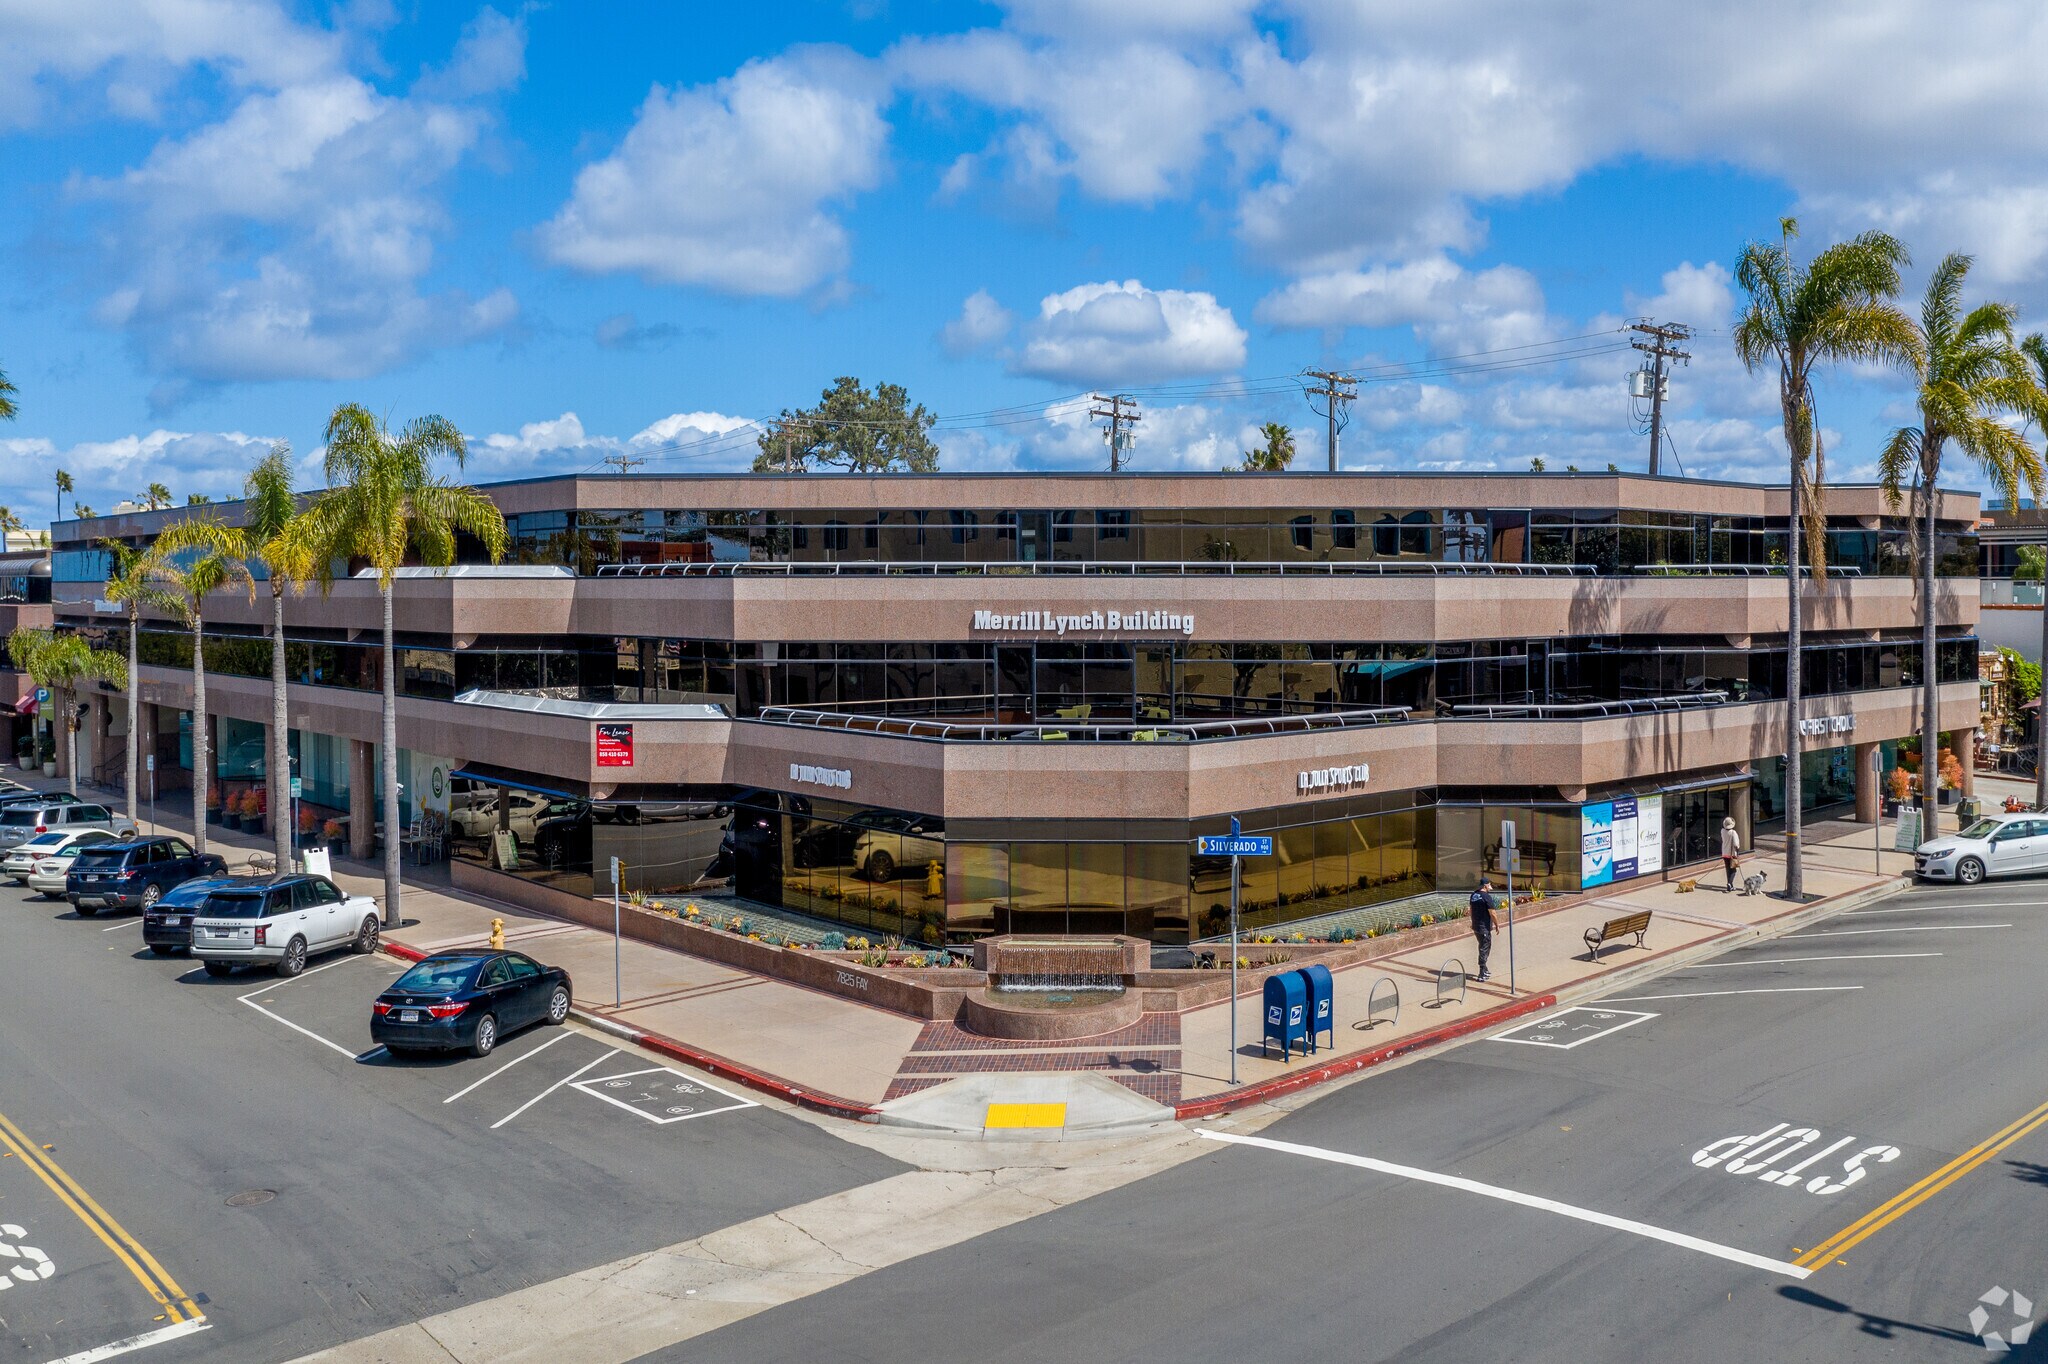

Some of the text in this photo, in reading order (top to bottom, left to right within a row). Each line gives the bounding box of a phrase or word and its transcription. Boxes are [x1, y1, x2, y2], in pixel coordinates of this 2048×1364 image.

[974, 611, 1194, 635] Merrill Lynch Building
[38, 689, 48, 701] P
[599, 727, 630, 737] For Lease
[1807, 718, 1829, 735] FIRST
[1210, 839, 1257, 852] SILVERADO
[836, 970, 869, 991] 7825 FAY
[1692, 1122, 1901, 1195] STOP
